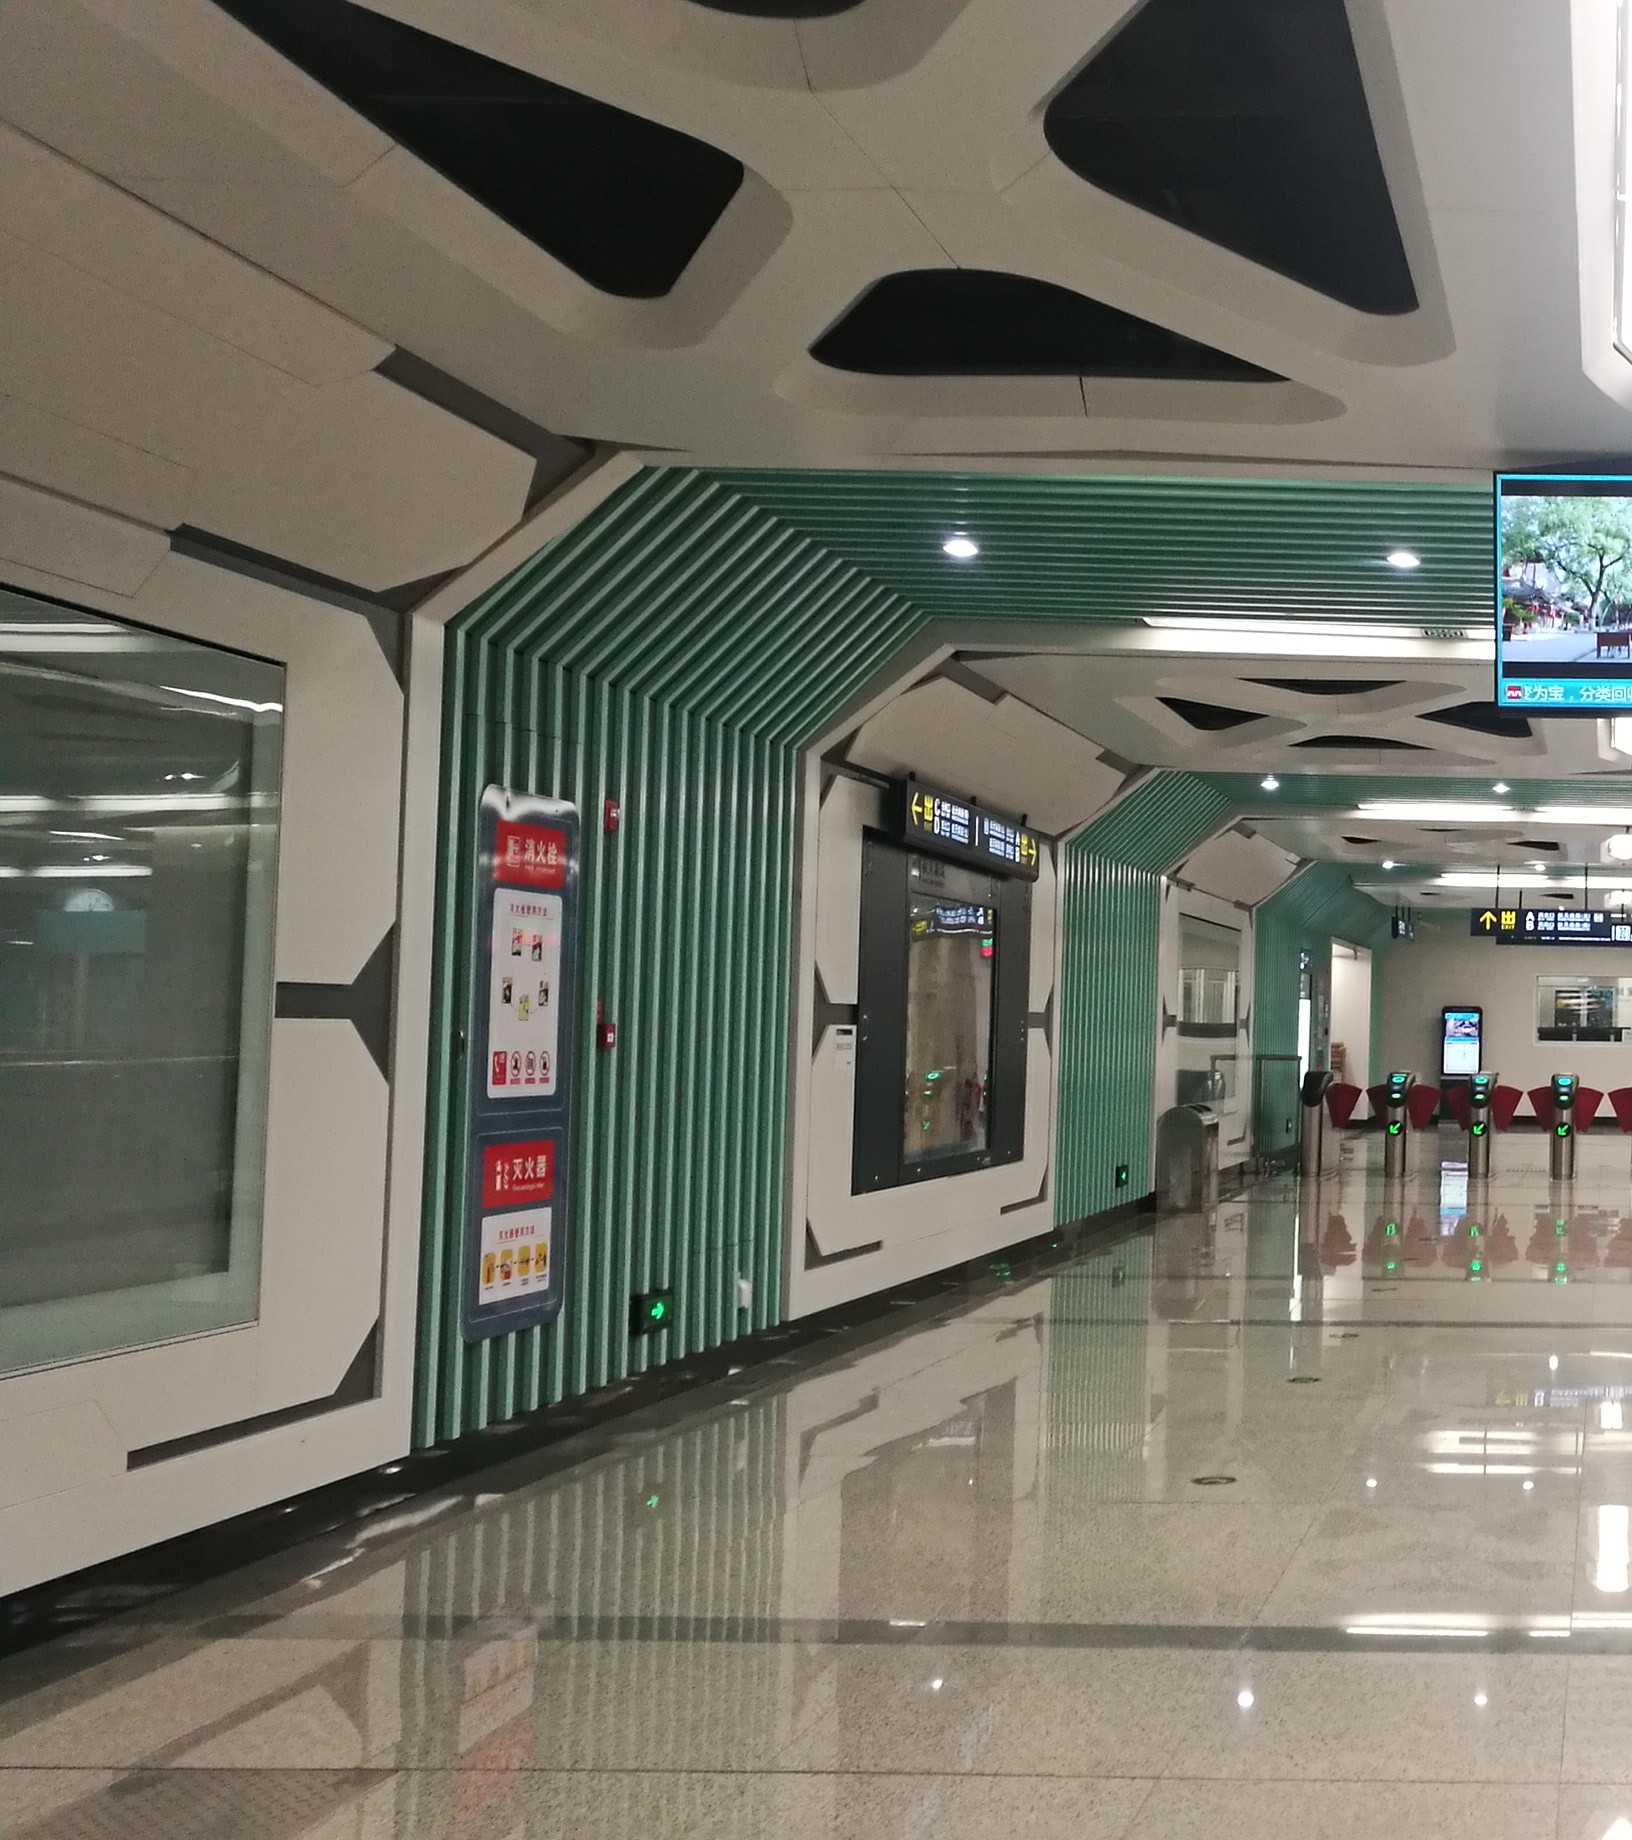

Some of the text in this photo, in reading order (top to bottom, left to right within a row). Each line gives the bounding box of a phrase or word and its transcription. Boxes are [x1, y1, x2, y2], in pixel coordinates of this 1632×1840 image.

[934, 798, 941, 816] C
[934, 816, 940, 834] D
[524, 838, 557, 865] 消火栓
[1525, 911, 1535, 921] A
[512, 1155, 547, 1181] 灭火器
